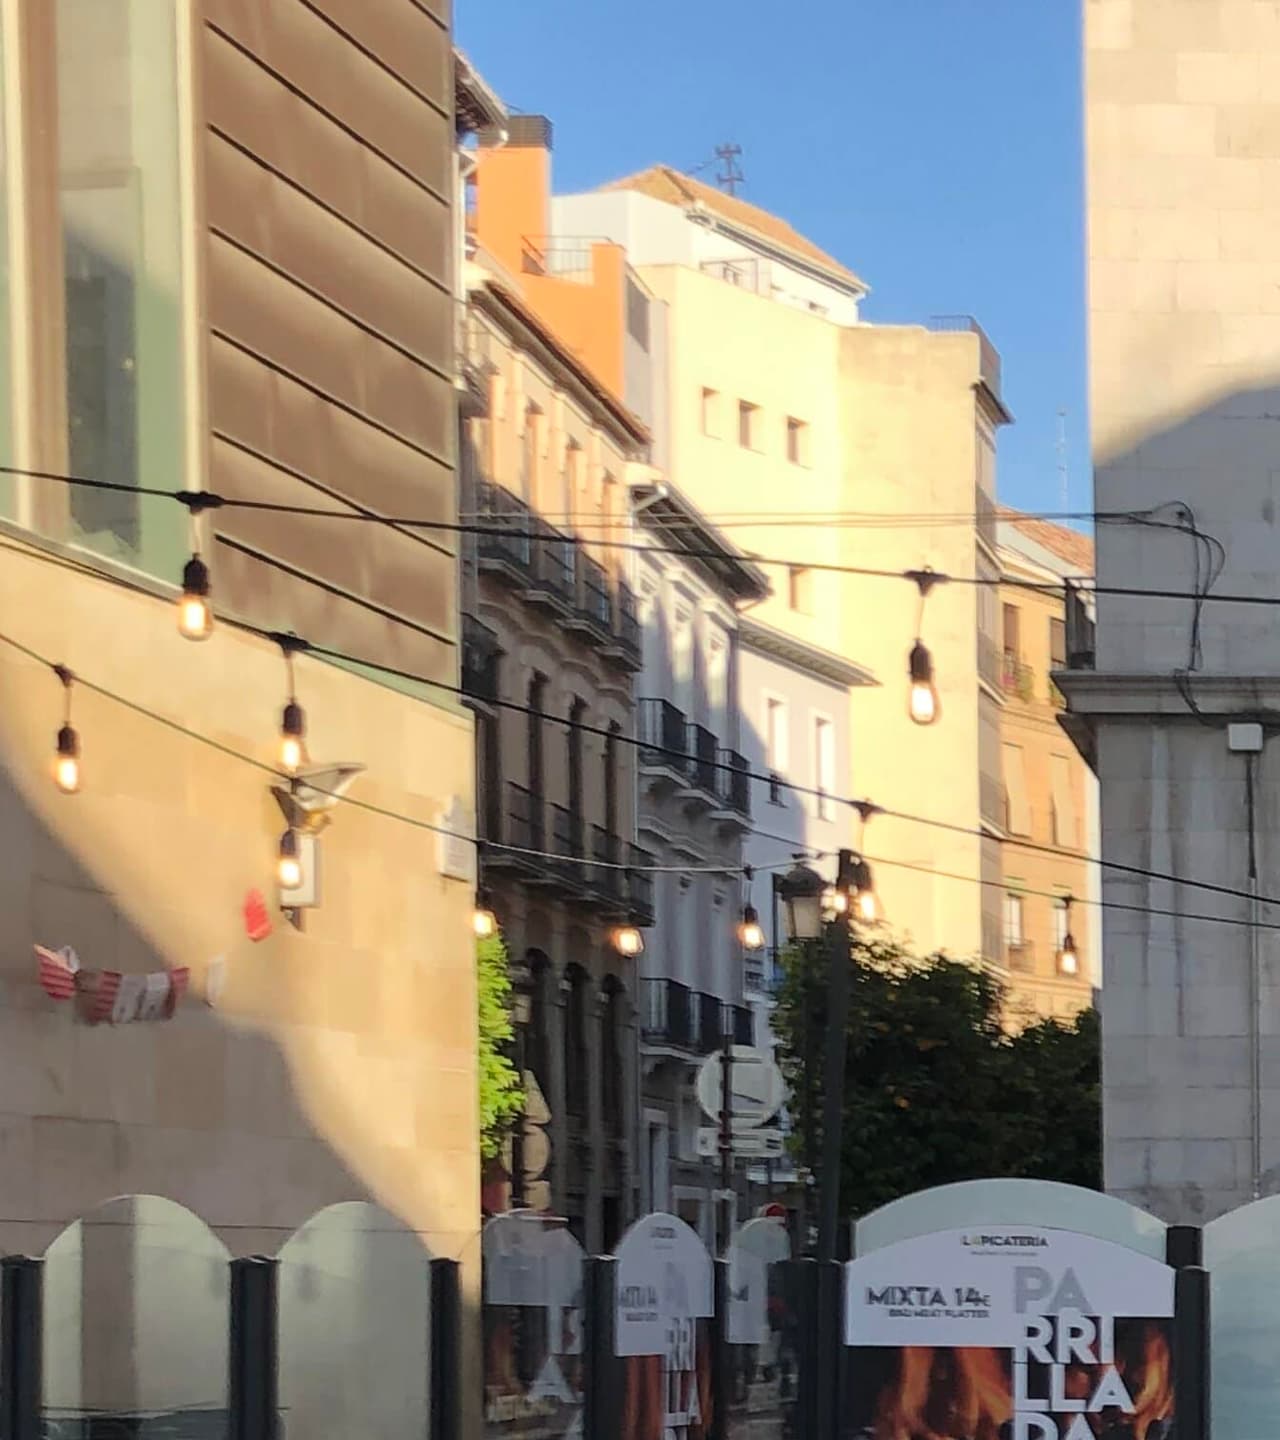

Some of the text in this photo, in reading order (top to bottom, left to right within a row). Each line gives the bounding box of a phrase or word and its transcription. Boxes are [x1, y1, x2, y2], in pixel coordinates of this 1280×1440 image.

[866, 1286, 947, 1306] MIXTA
[1013, 1265, 1094, 1314] PA
[1014, 1314, 1115, 1364] RRI
[1013, 1363, 1136, 1414] LLA
